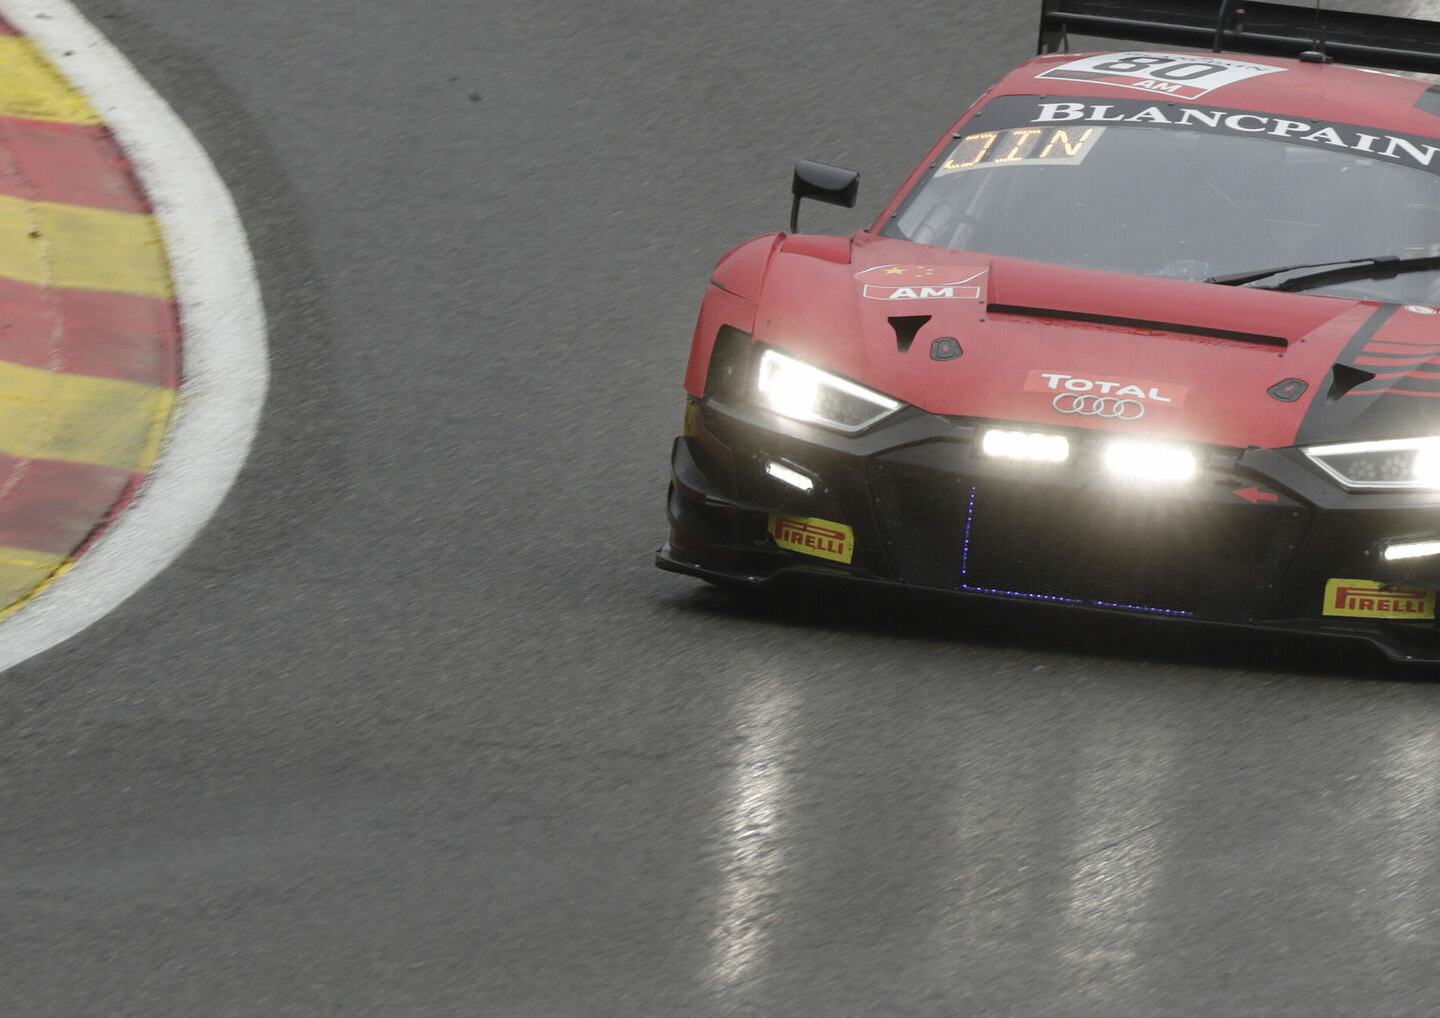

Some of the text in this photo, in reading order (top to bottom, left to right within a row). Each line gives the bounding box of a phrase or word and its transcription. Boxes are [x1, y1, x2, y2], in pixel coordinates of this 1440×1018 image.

[1092, 56, 1229, 81] 80
[1132, 79, 1182, 93] AM
[943, 129, 1093, 169] JIN
[888, 286, 955, 299] AM
[1041, 373, 1171, 402] TOTAL
[775, 517, 846, 555] PIRELLI
[1335, 586, 1427, 613] PIRELLI
